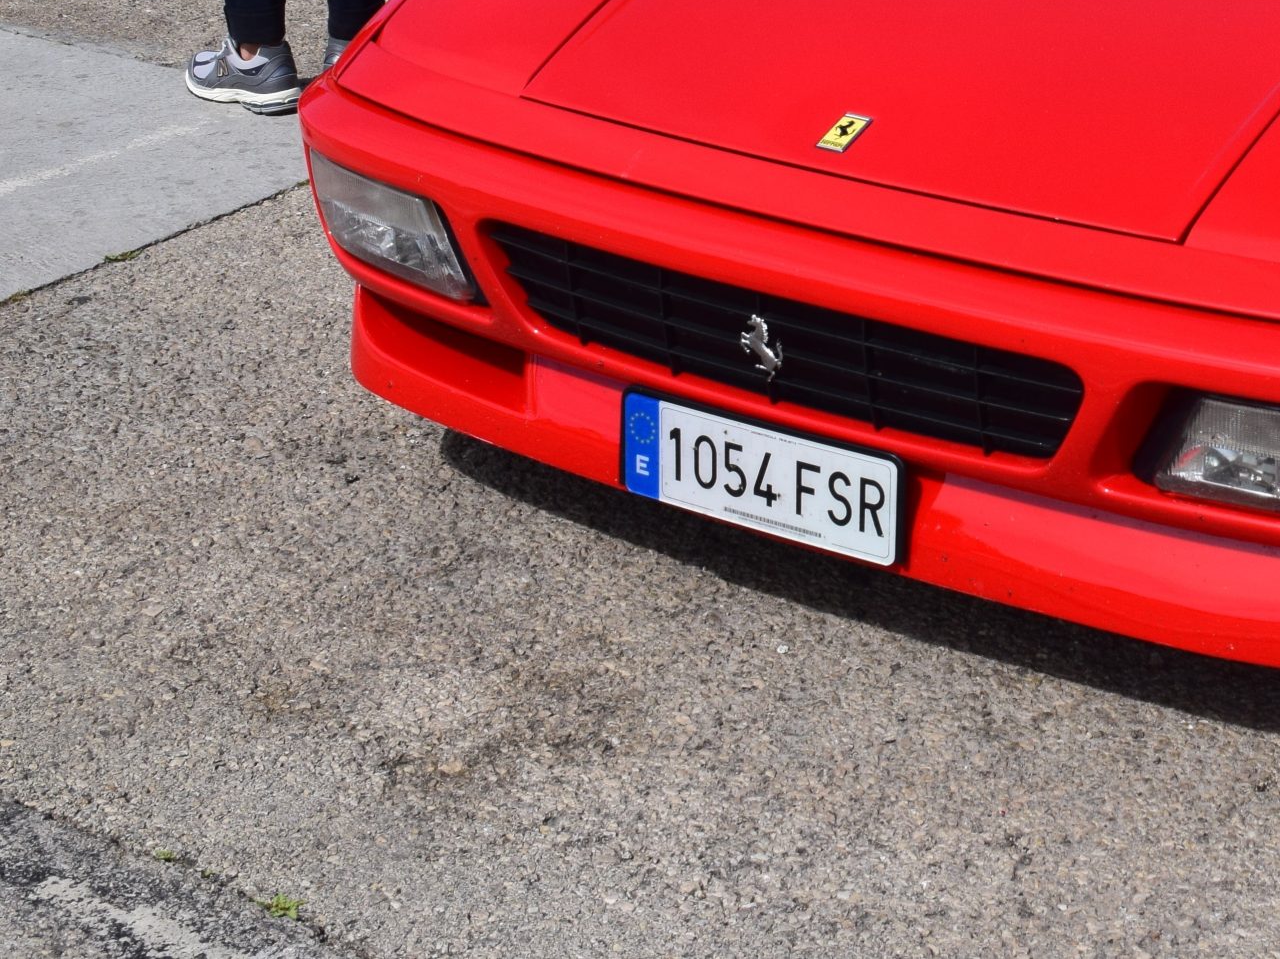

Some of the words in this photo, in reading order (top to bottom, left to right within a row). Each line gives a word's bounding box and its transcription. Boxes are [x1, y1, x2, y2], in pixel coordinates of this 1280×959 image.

[635, 454, 650, 476] E
[669, 427, 777, 508] 1054
[795, 460, 885, 538] FSR
